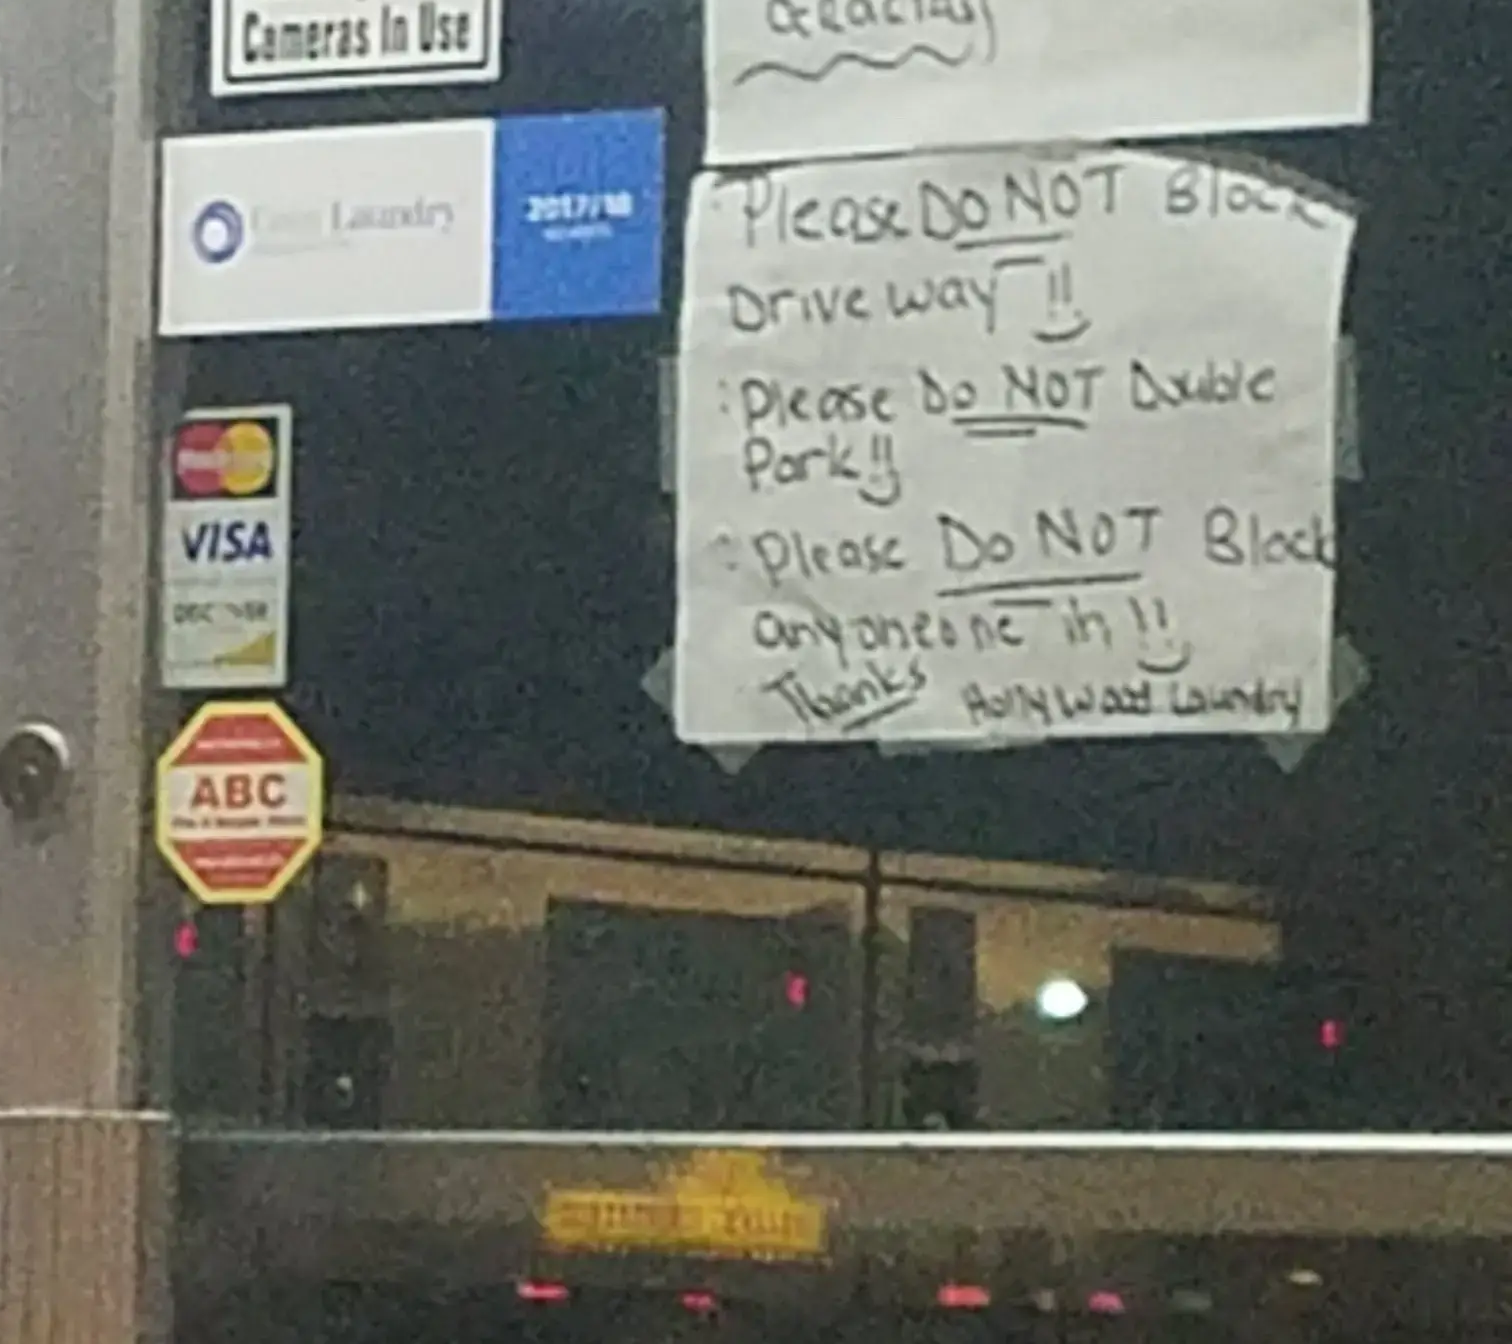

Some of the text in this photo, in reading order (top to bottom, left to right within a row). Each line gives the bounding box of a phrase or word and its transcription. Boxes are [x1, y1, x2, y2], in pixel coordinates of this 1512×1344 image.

[243, 2, 471, 63] Cameras In Use
[742, 176, 911, 248] Please
[1004, 162, 1128, 223] NOT
[740, 374, 897, 435] Please
[1000, 362, 1108, 412] NOT
[1129, 356, 1278, 412] Double
[181, 520, 274, 563] VISA
[750, 528, 907, 590] Please
[1034, 505, 1165, 559] NOT
[1063, 595, 1113, 651] in
[760, 652, 929, 732] Thanks
[190, 772, 288, 810] ABC
